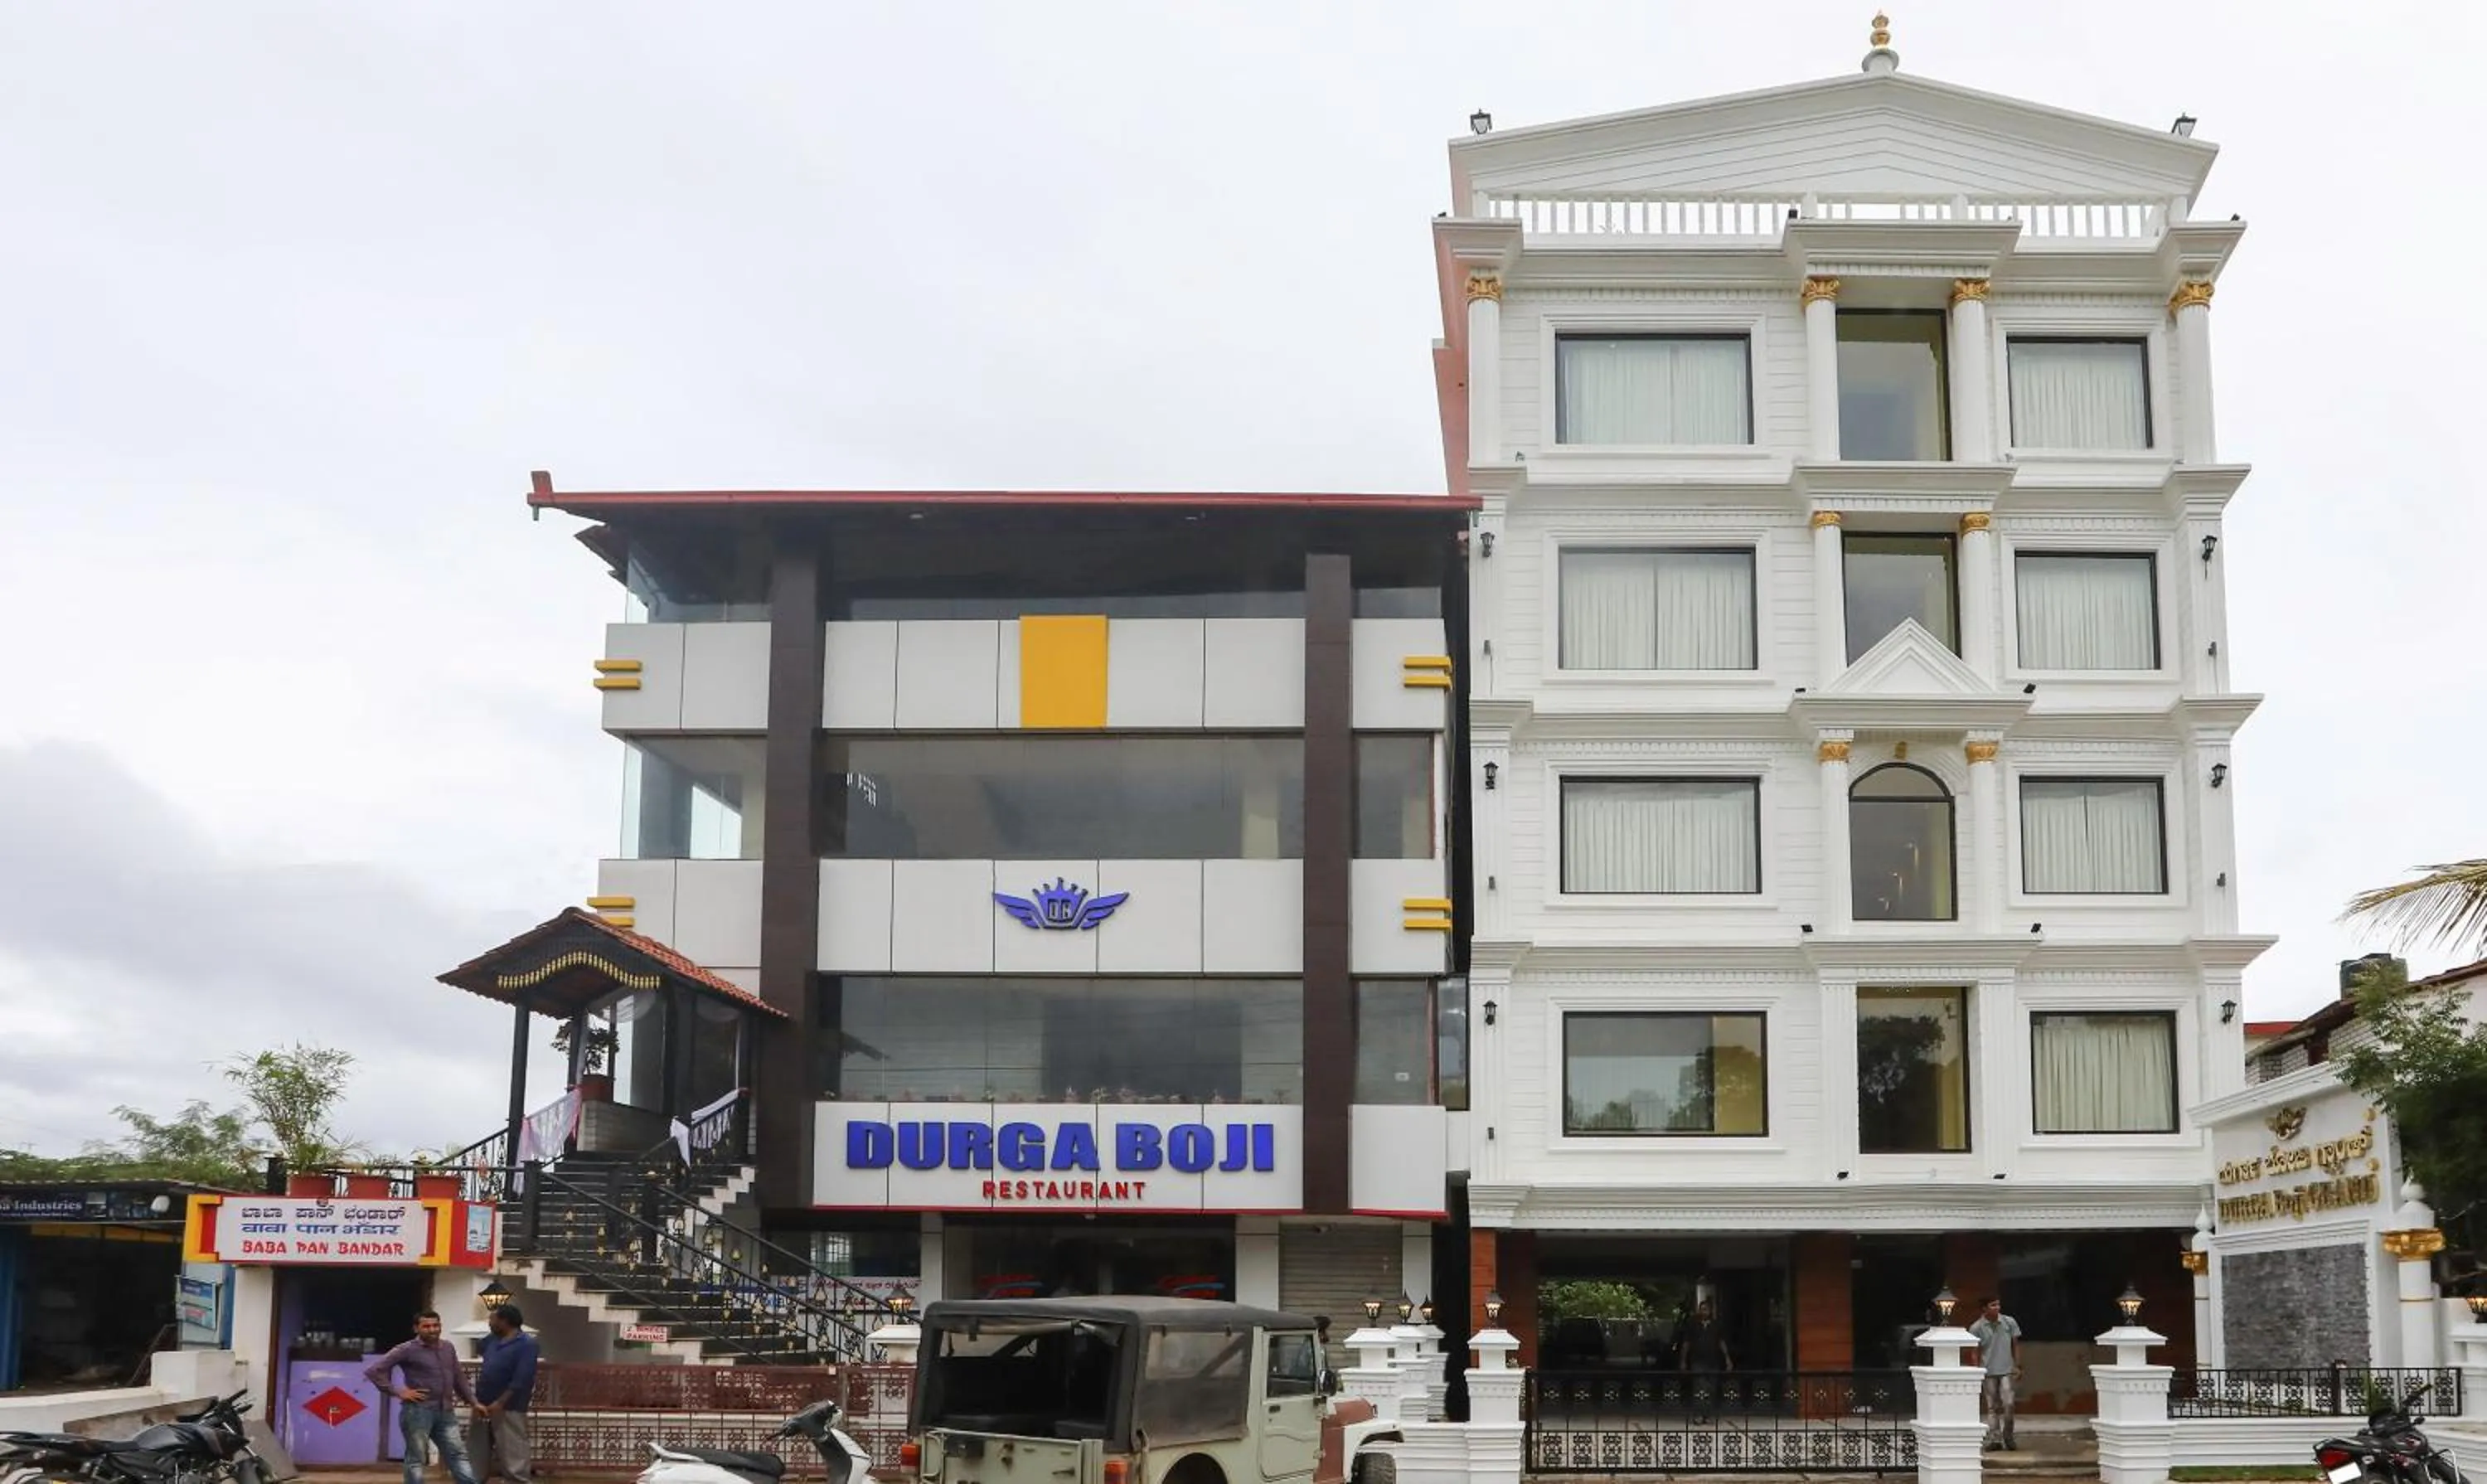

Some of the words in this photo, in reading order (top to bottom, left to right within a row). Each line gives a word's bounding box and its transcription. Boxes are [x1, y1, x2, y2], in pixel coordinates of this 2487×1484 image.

[846, 1120, 1099, 1171] DURGA
[1116, 1122, 1274, 1173] BOJI
[982, 1179, 1146, 1200] RESTAURANT
[13, 1200, 82, 1210] Industries
[296, 1224, 339, 1234] पान
[243, 1239, 287, 1254] BABA
[296, 1240, 329, 1254] PAN
[337, 1241, 405, 1256] BANDAR
